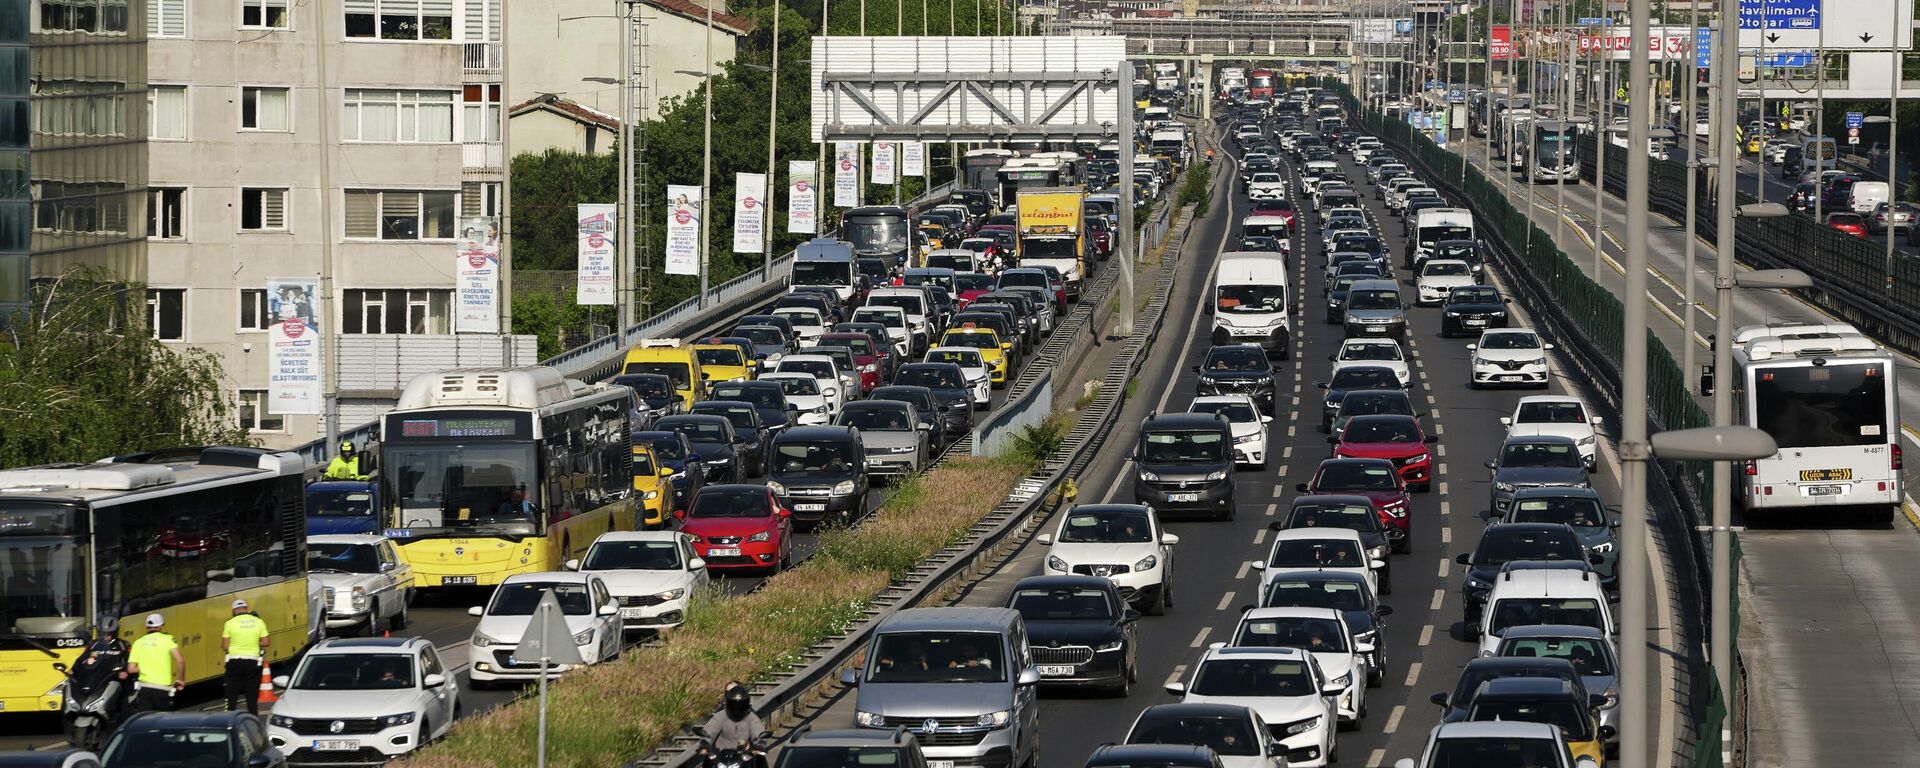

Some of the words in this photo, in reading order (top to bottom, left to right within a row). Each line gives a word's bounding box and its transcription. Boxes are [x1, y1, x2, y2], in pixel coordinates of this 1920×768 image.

[1580, 37, 1659, 49] BAUHS
[1037, 666, 1045, 674] 34
[1061, 666, 1073, 674] 730
